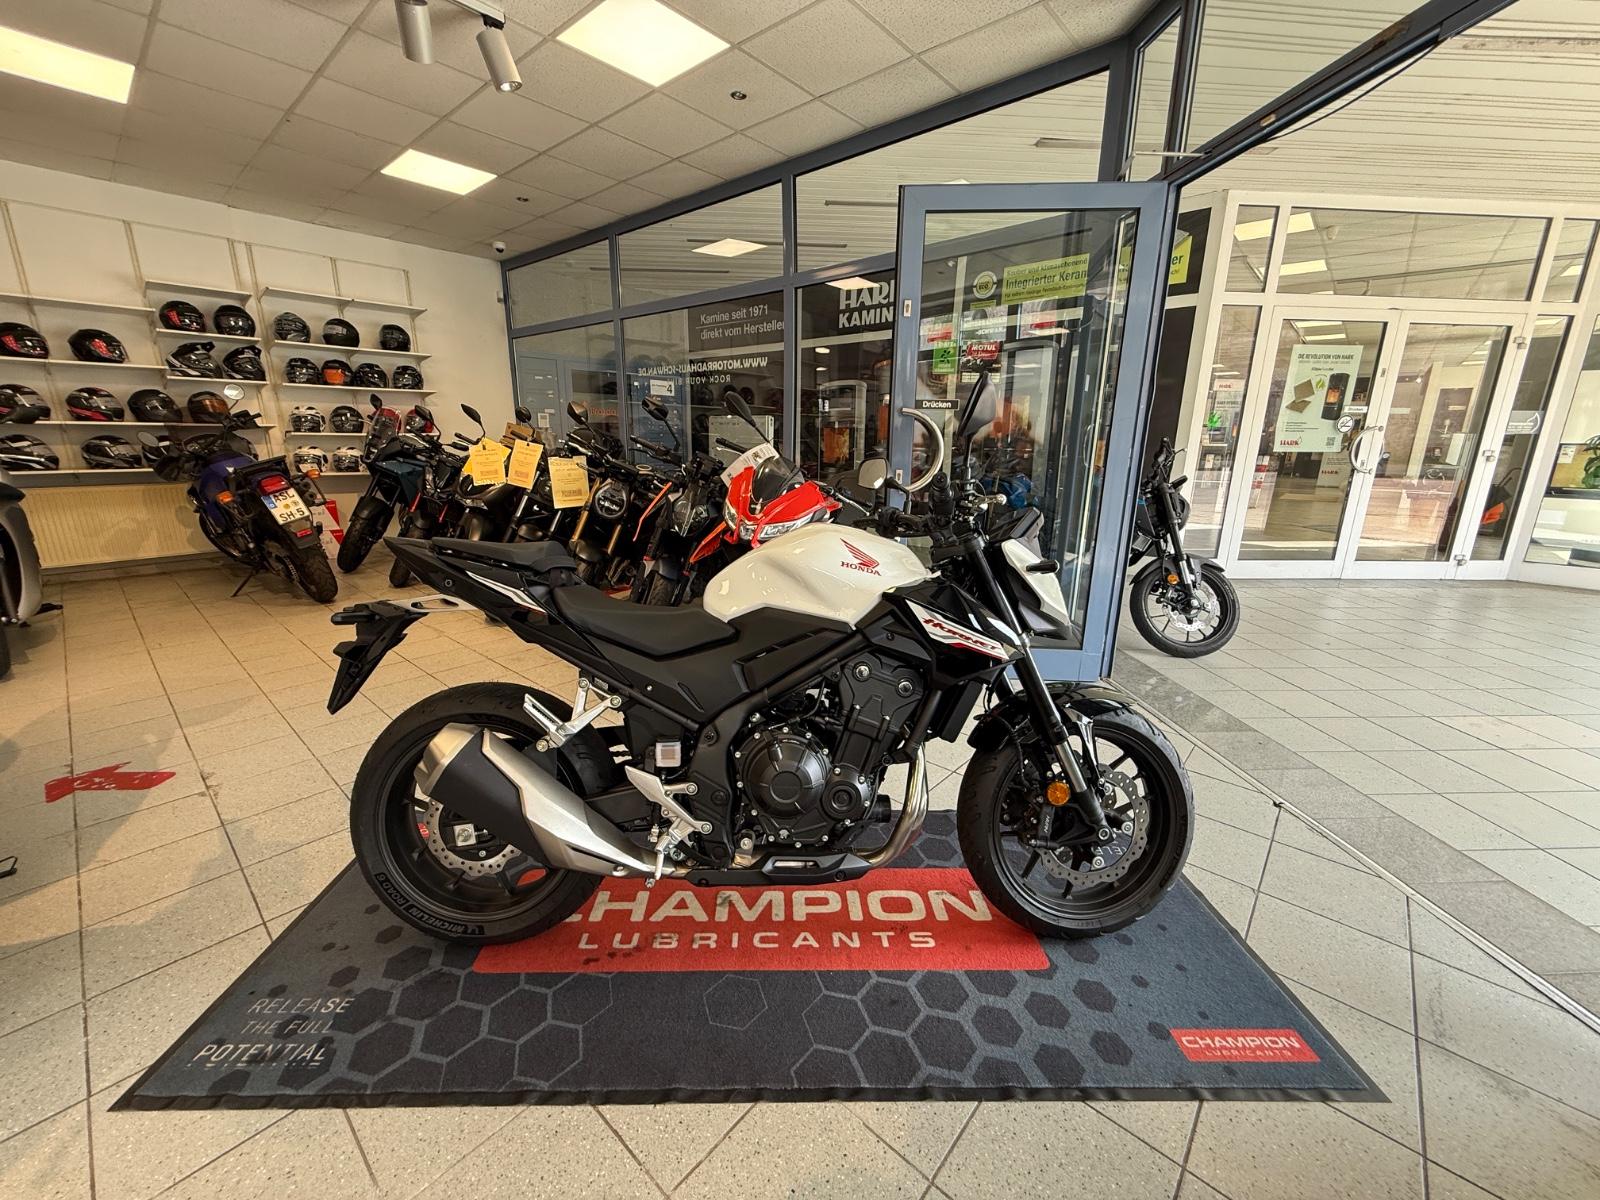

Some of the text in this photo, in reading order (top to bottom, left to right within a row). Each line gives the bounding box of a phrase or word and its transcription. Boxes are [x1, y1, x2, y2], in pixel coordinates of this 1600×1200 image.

[1006, 274, 1056, 290] Integrierter
[700, 303, 768, 325] Kamine seit 1971
[838, 306, 894, 329] KAMIN
[700, 327, 723, 340] direkt
[724, 327, 742, 337] vom
[922, 400, 952, 408] Drücken
[279, 510, 296, 522] SH
[296, 507, 305, 516] 5
[840, 560, 882, 577] HONDA
[382, 881, 407, 905] ROAD
[563, 889, 992, 923] HAMPION
[408, 906, 465, 934] MICHELIN
[578, 932, 937, 949] LUBRICANTS
[247, 997, 355, 1014] RELEASE
[240, 1020, 335, 1035] THE FULL
[1180, 1036, 1301, 1049] CHAMPION
[190, 1043, 326, 1066] POTENTIAL
[1205, 1049, 1293, 1057] LUBRICANTS
